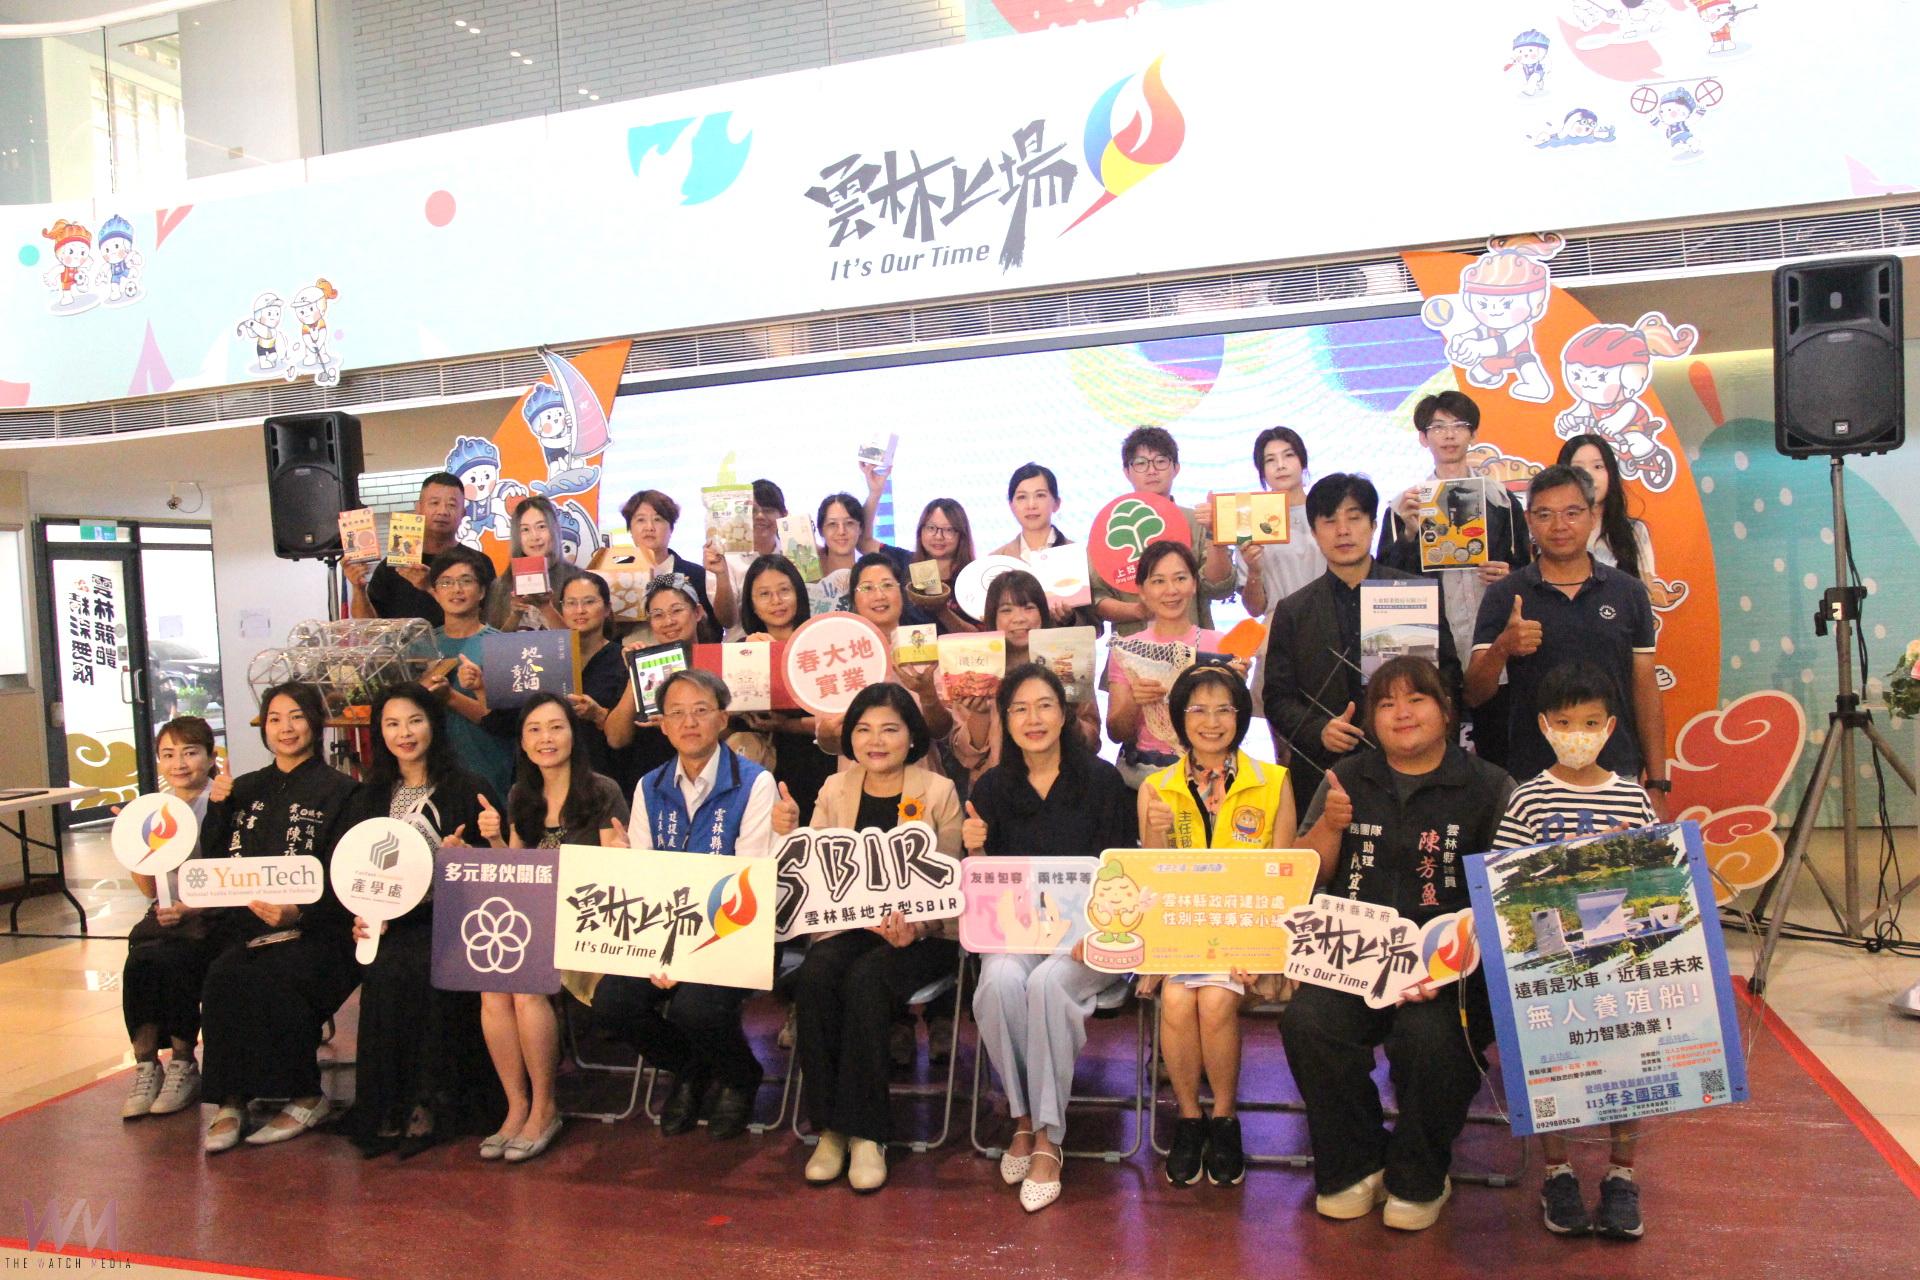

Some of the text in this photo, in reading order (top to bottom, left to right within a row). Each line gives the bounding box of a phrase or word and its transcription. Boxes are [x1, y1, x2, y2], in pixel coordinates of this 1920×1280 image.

[804, 119, 1078, 276] 雲林上場
[831, 244, 991, 281] It's Our Time
[796, 636, 874, 674] 春大地
[816, 667, 868, 699] 實業
[710, 808, 727, 855] 雲林縣
[214, 865, 316, 888] YunTech
[444, 862, 553, 884] 多元夥伙關係
[775, 828, 955, 935] SBIR
[970, 871, 1023, 884] 友善包容
[1038, 871, 1092, 885] 兩性平等
[352, 879, 402, 898] 產學處
[1163, 893, 1286, 910] 雲林縣政府建設處
[566, 883, 704, 968] 雲林上場
[1321, 898, 1391, 923] 雲林縣政府
[575, 940, 657, 958] It's Our Time
[1284, 911, 1419, 1000] 雲林上場
[1288, 962, 1369, 989] It's Our Time
[1514, 955, 1705, 1000] 遠看是水車，近看是未來
[1526, 983, 1701, 1031] 無人養殖船！
[1569, 1017, 1673, 1046] 助力智慧漁業！
